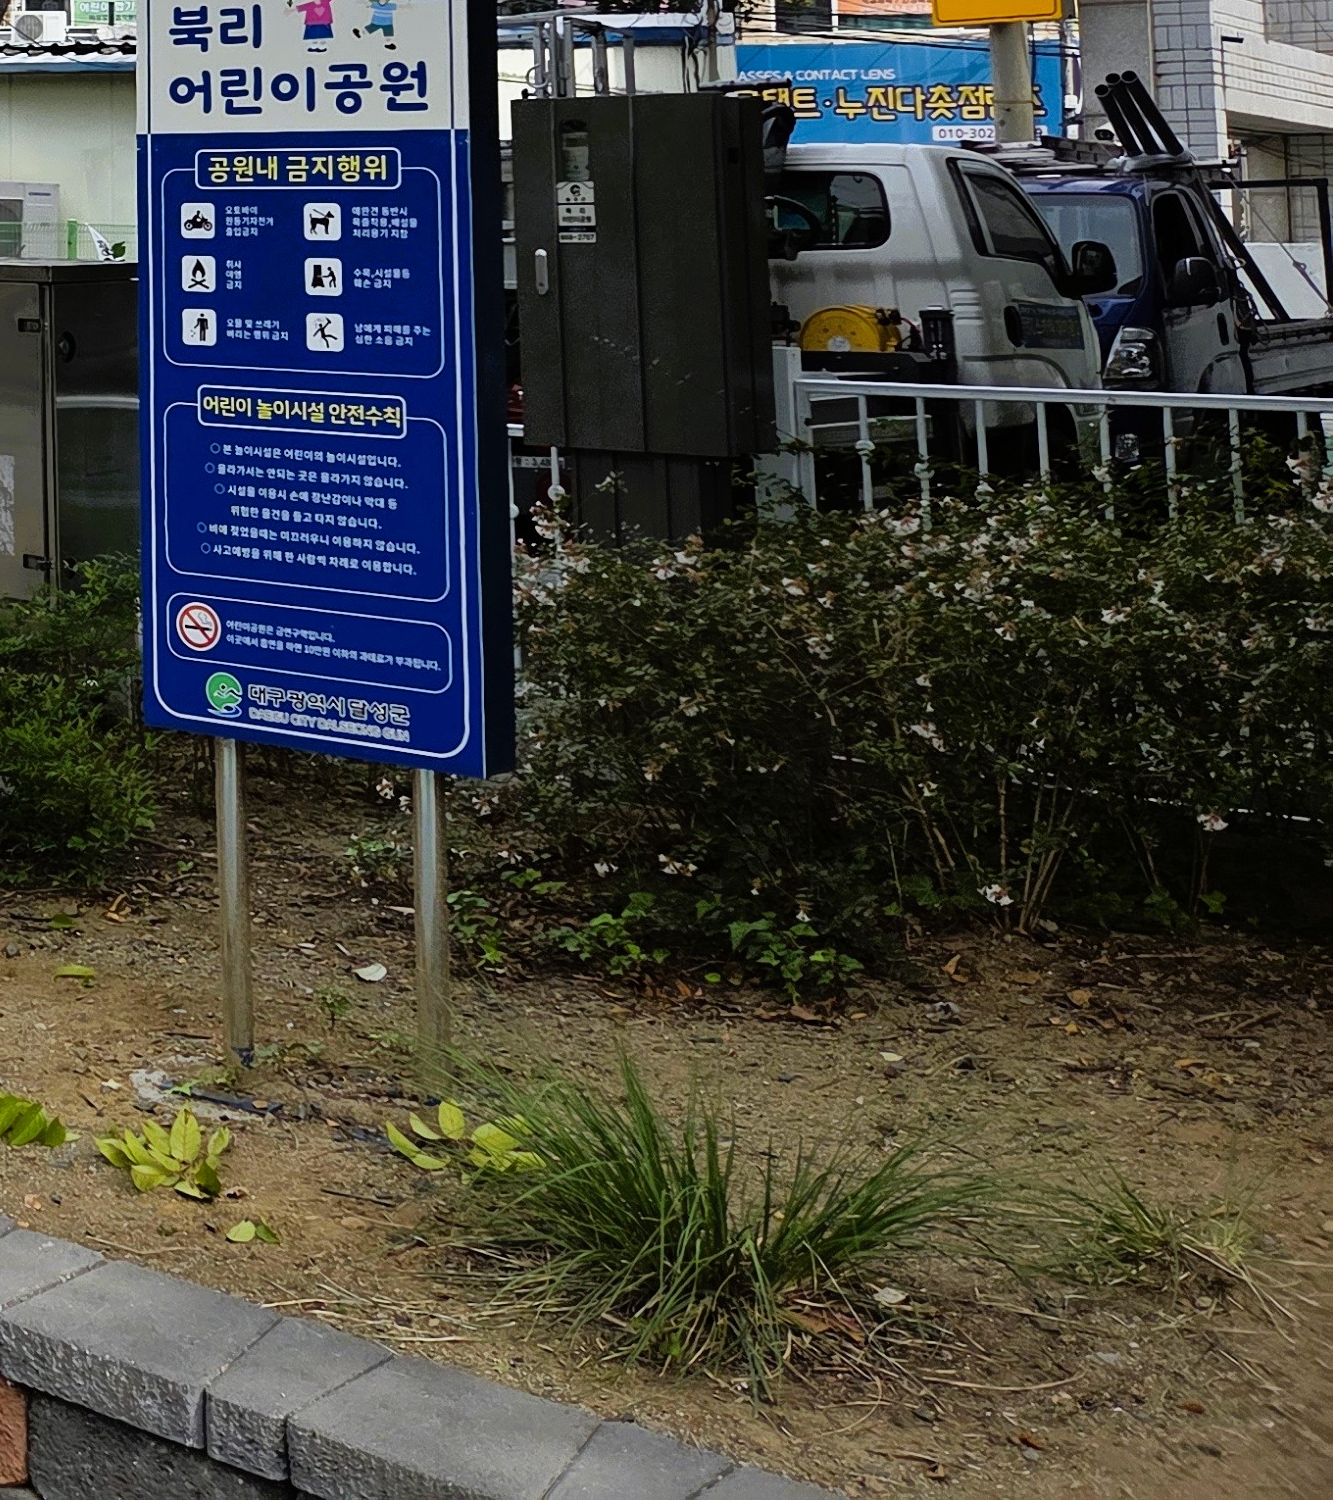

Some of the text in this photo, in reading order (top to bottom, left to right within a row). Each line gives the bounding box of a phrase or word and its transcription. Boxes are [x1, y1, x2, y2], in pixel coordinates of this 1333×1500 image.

[169, 3, 263, 53] 북리
[169, 60, 429, 115] 어린이공원
[737, 70, 783, 81] ASSES
[796, 69, 858, 81] CONTACT
[860, 68, 896, 81] LENS
[938, 127, 996, 140] 010-302
[208, 155, 388, 182] 공원내 금지행위
[203, 396, 401, 428] 어린이 놀이시설 안전수칙
[247, 683, 411, 726] 대구광역시 달성군
